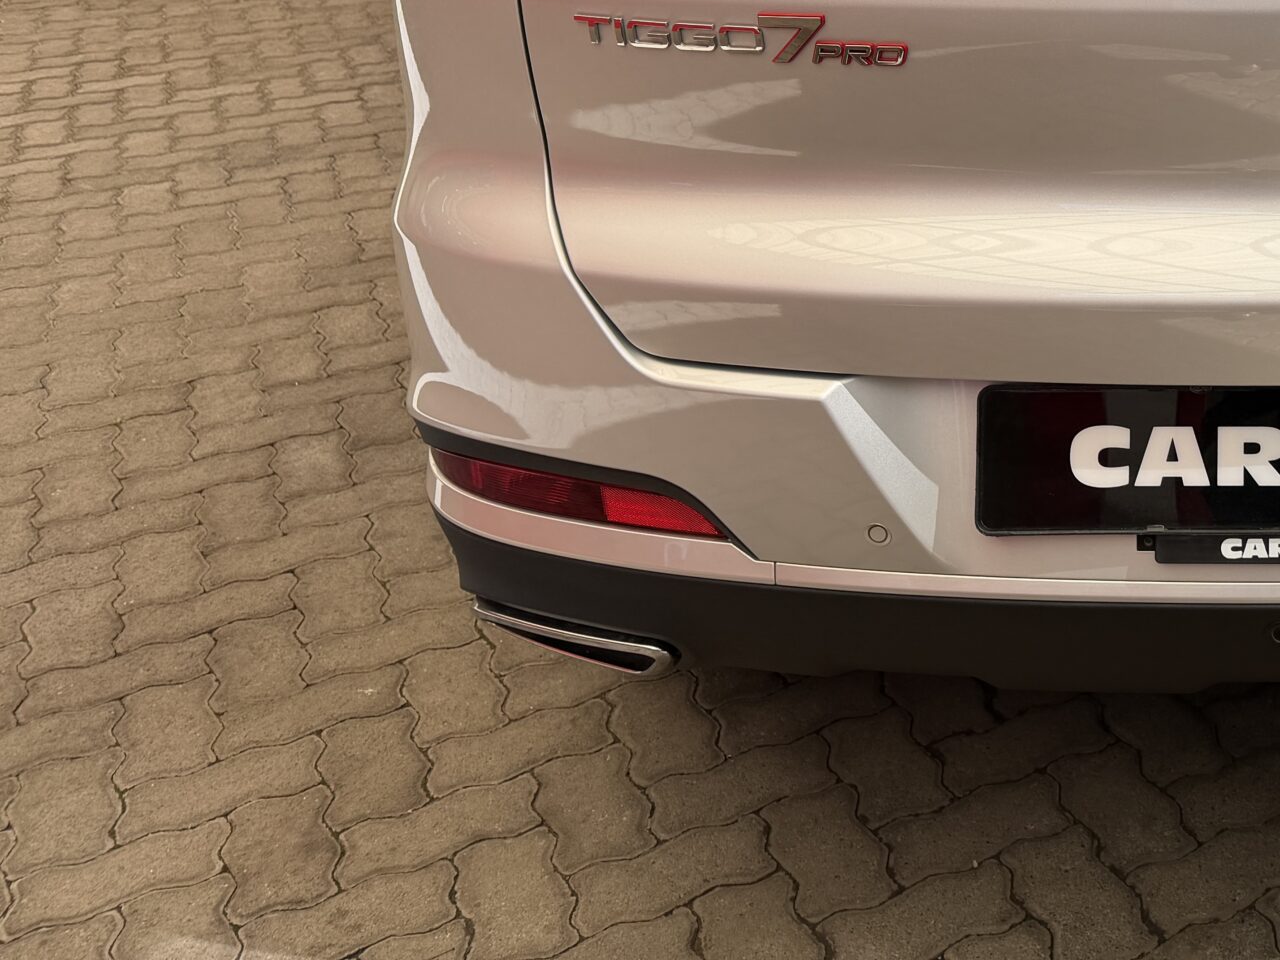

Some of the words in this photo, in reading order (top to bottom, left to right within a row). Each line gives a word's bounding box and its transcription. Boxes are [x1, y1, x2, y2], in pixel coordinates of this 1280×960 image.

[573, 11, 766, 53] TIGGO
[756, 11, 826, 64] 7
[811, 40, 909, 67] PRO
